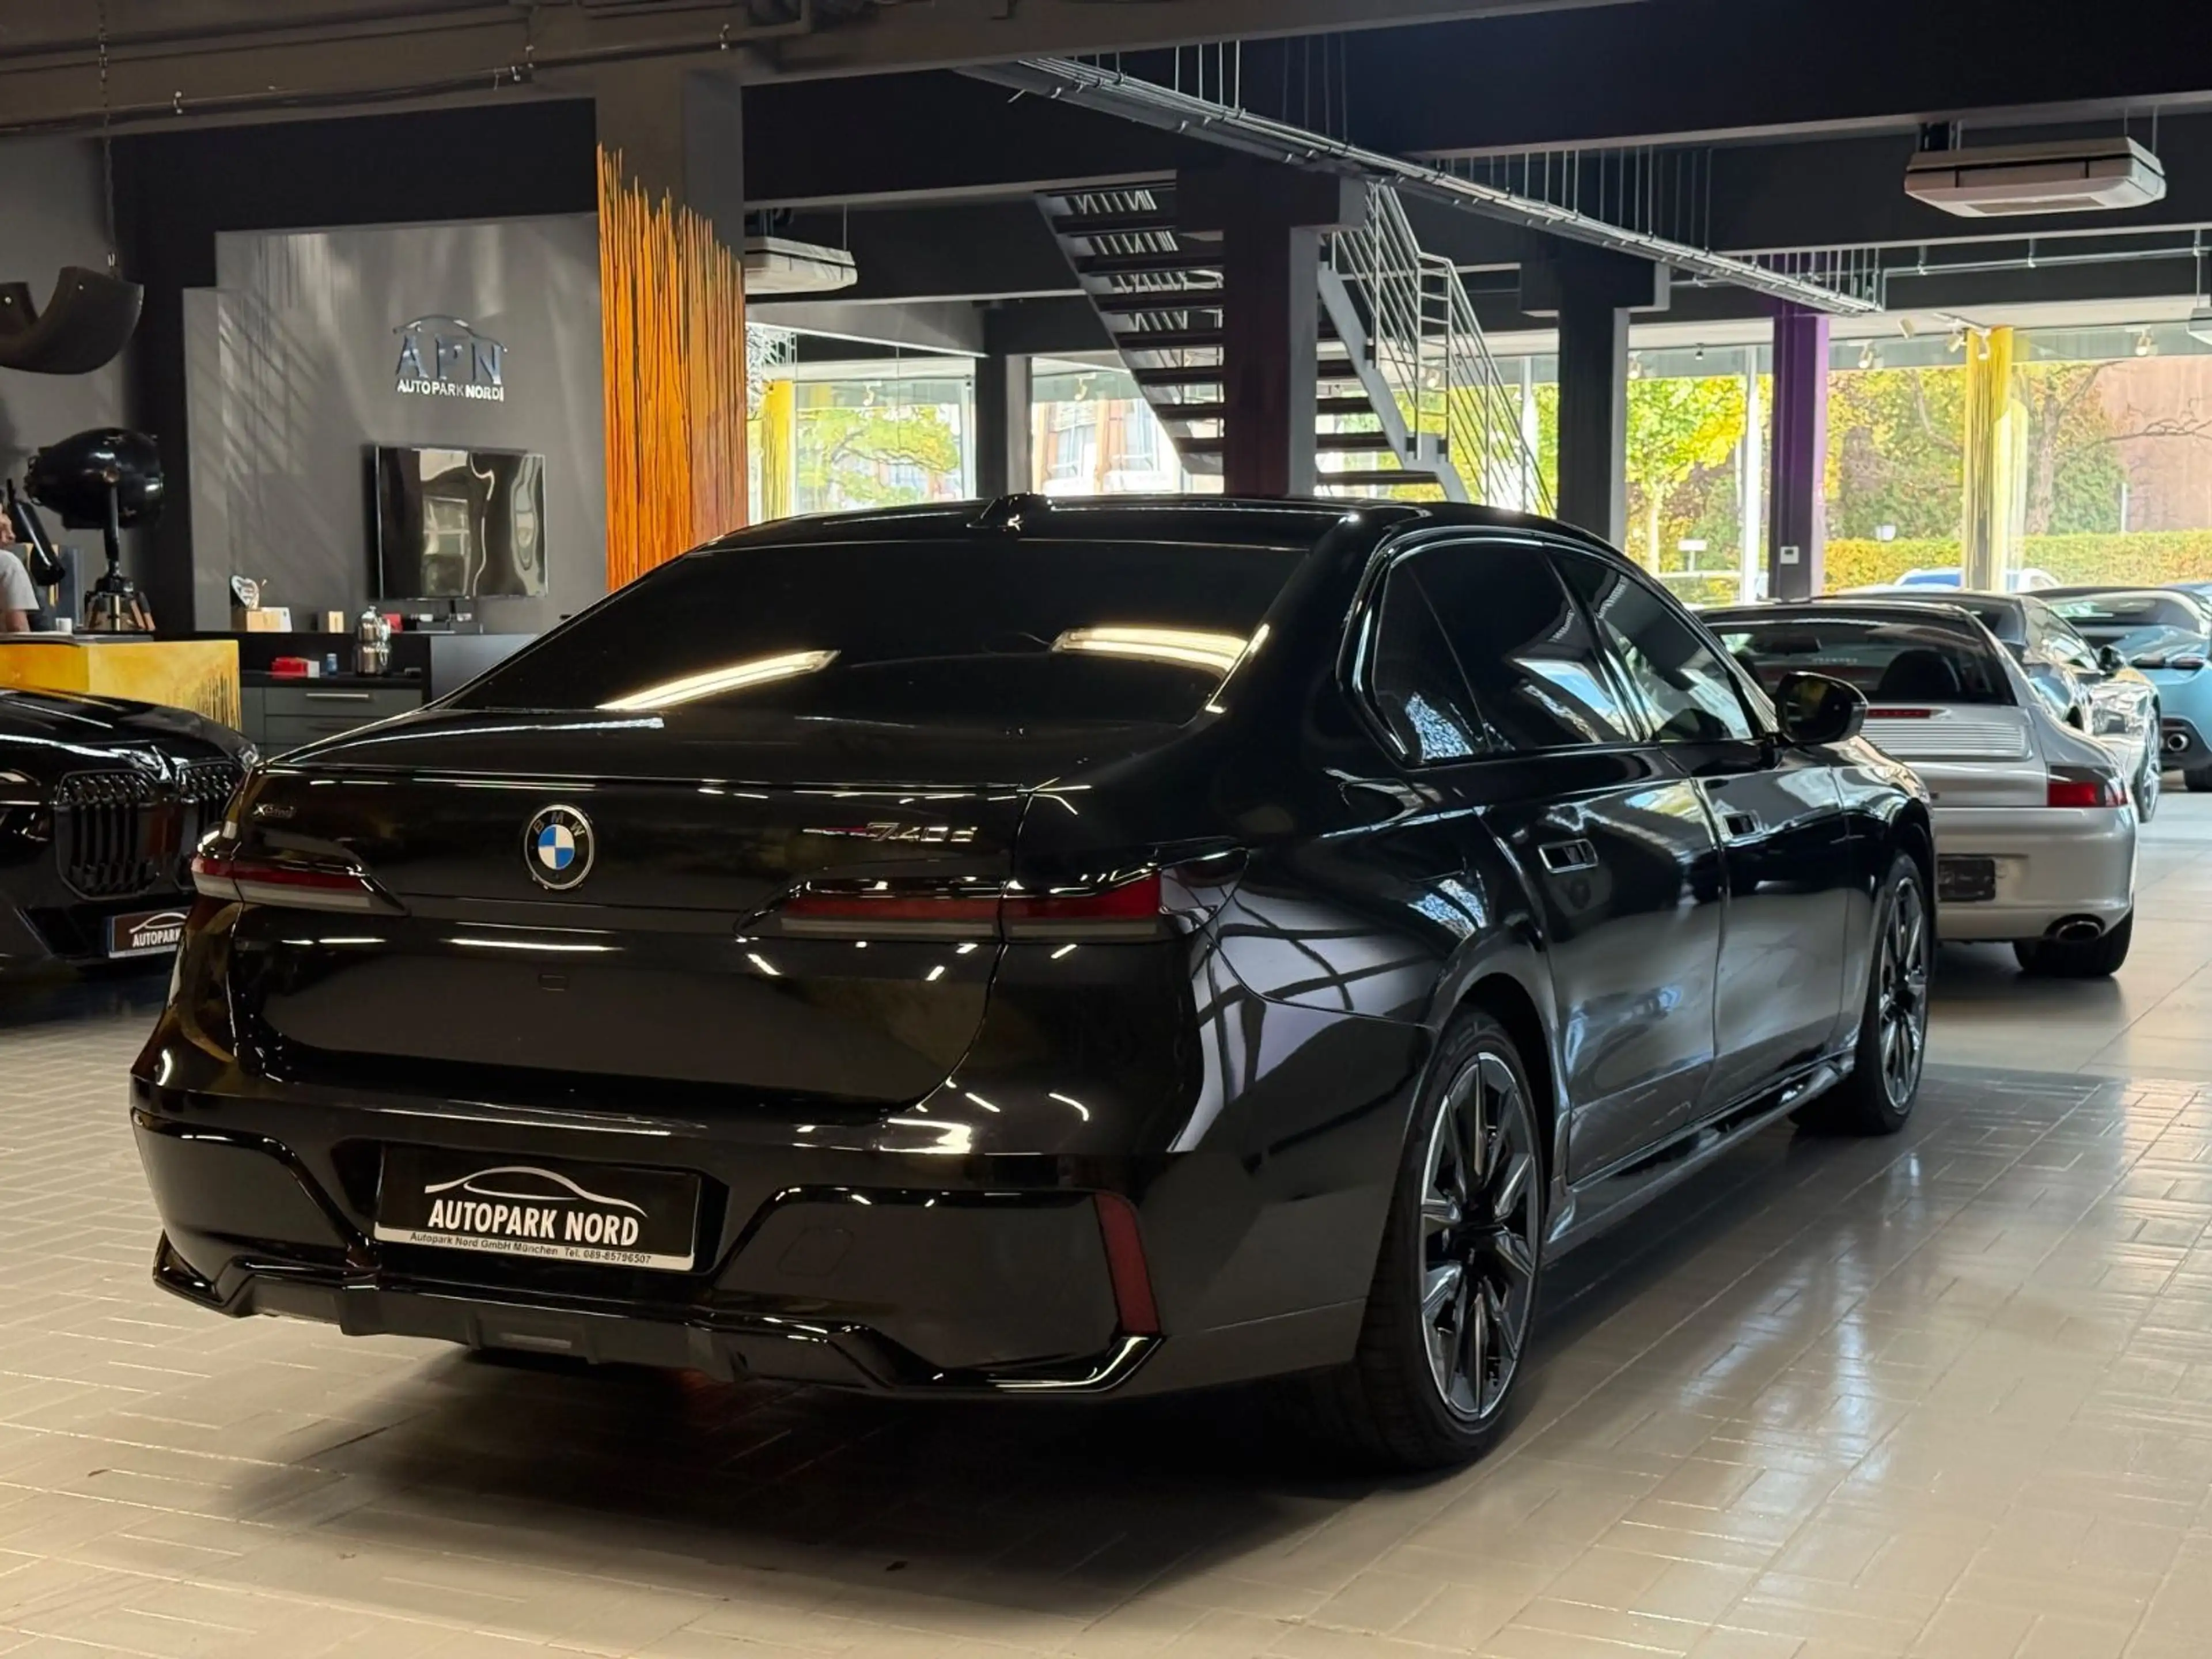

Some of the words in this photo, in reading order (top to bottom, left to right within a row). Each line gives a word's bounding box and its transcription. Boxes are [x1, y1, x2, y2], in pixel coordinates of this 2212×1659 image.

[396, 334, 502, 385] APN
[533, 812, 585, 836] BMW
[427, 1199, 557, 1239] AUTOPARK
[565, 1211, 638, 1246] NORD
[410, 1232, 452, 1245] Autopark
[455, 1236, 478, 1247] Nord
[481, 1239, 512, 1250] GmbH
[513, 1242, 558, 1255] München
[563, 1246, 580, 1257] Tel.
